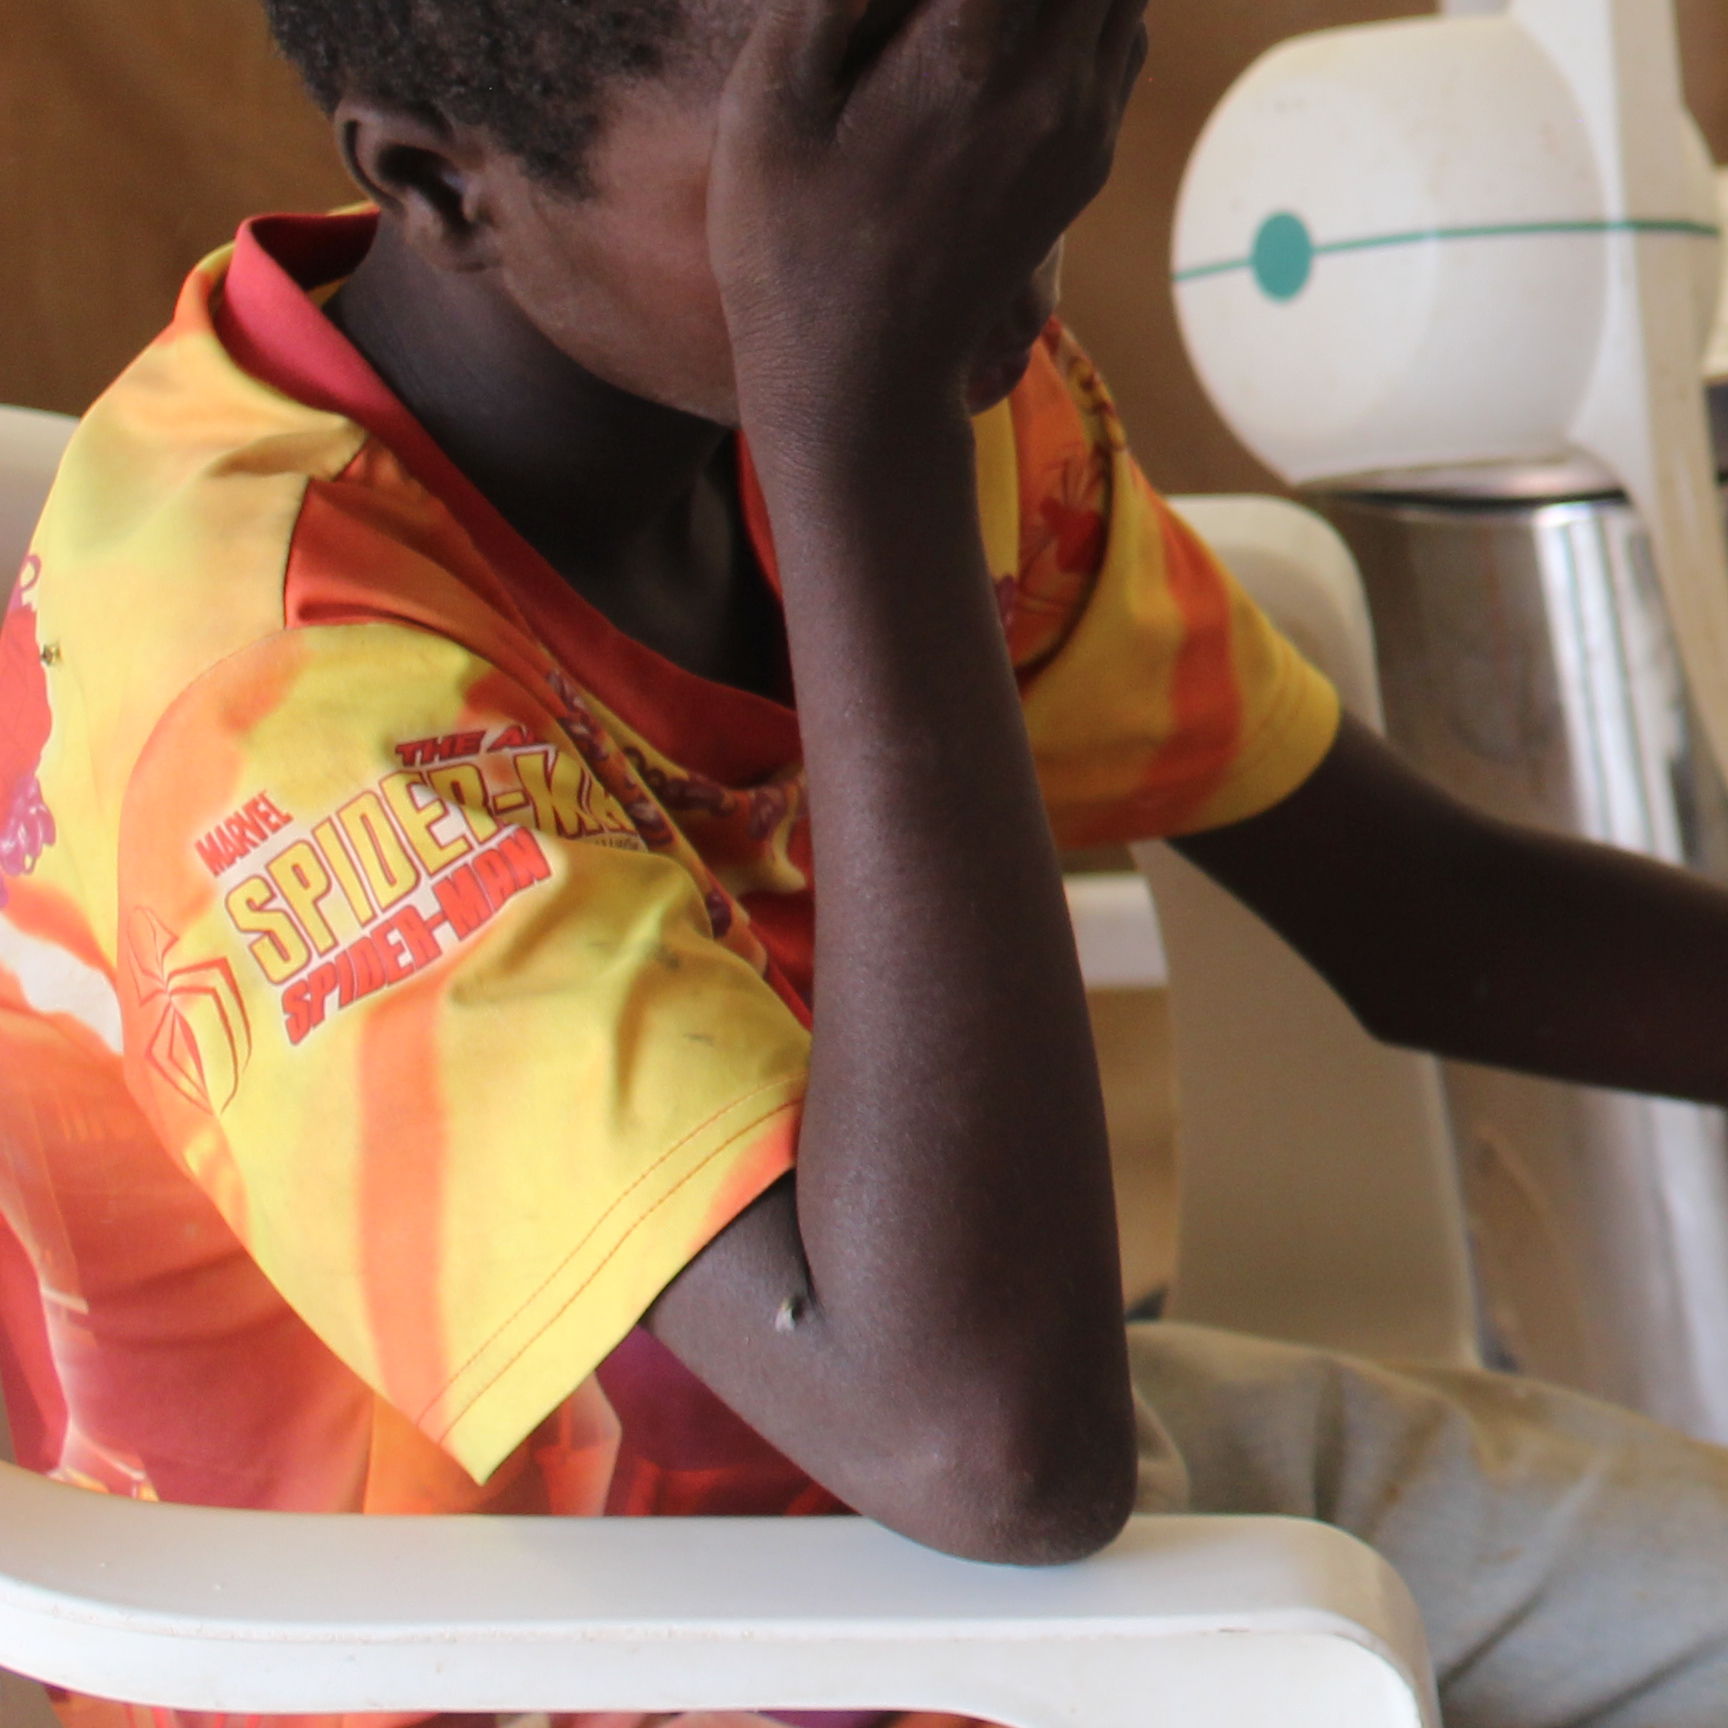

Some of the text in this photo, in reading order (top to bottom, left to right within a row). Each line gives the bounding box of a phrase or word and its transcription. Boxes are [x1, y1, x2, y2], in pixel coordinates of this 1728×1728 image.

[395, 729, 487, 768] THE
[194, 789, 294, 877] MARVEL
[281, 824, 553, 1046] SPIDER-MAN
